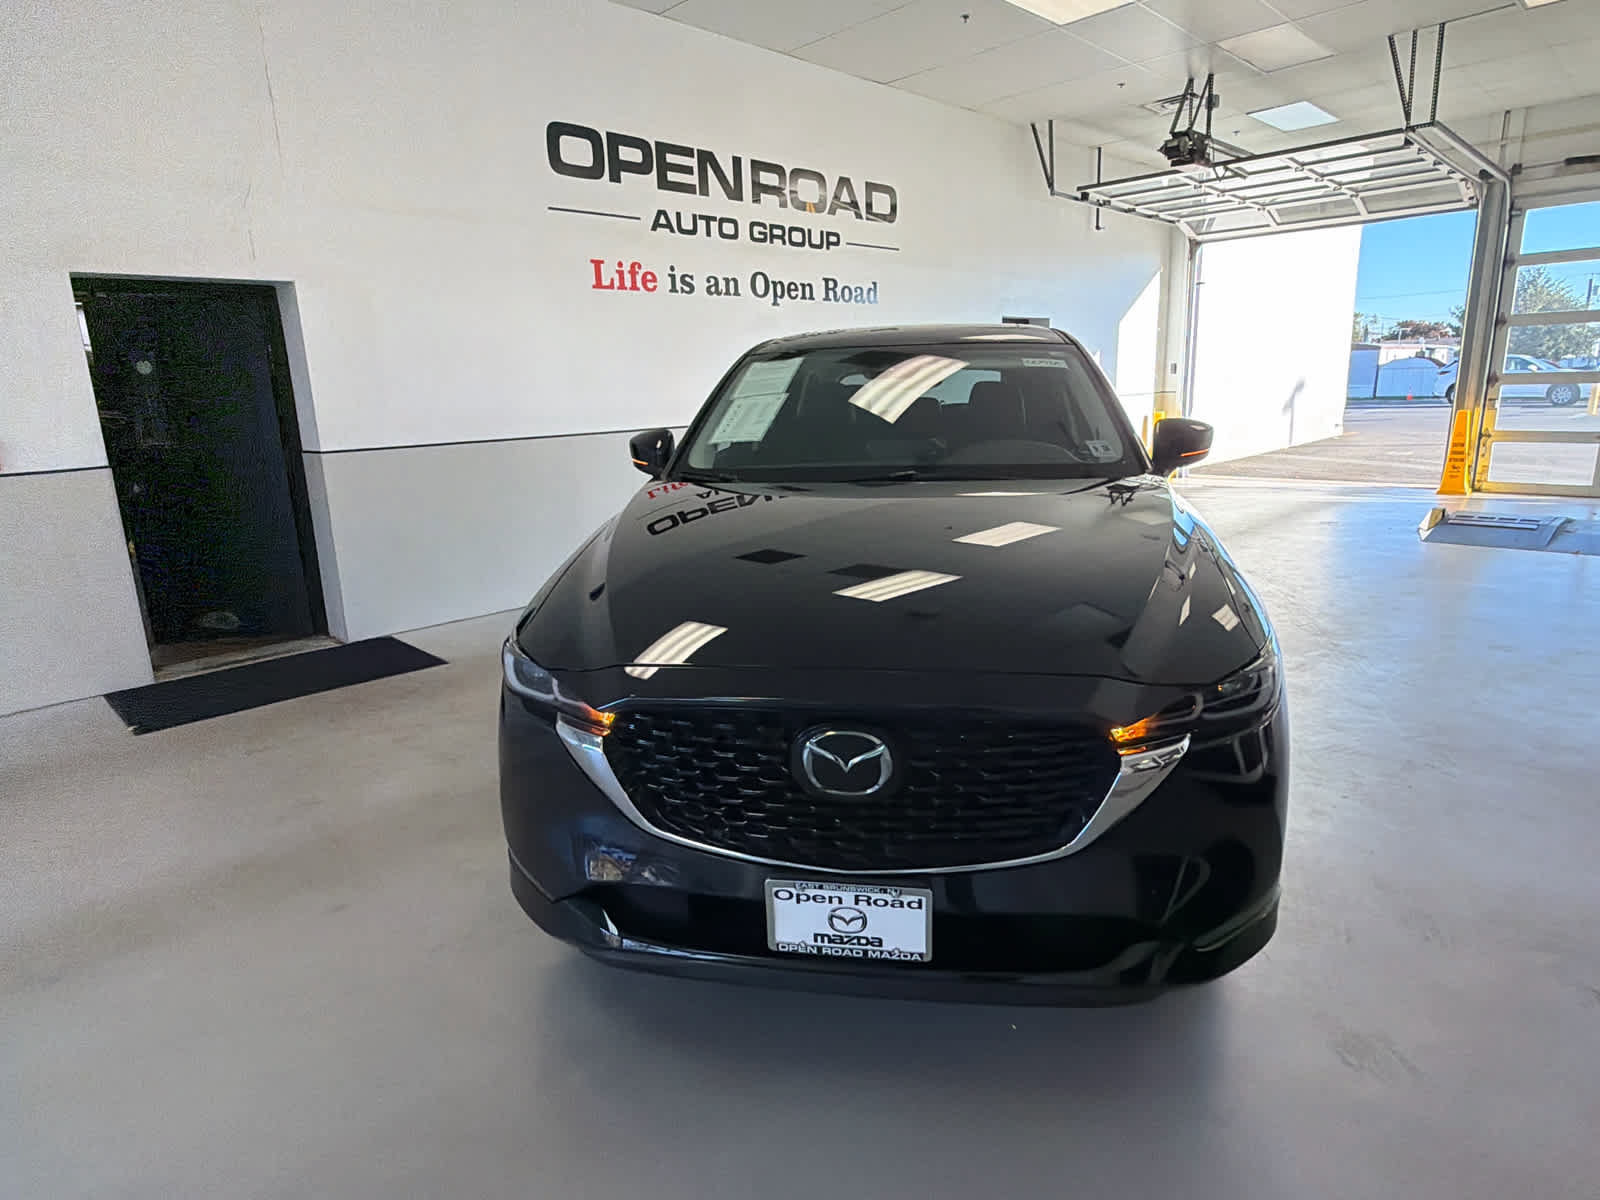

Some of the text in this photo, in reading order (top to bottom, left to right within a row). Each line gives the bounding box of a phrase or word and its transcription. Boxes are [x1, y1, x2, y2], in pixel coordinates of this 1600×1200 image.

[546, 121, 897, 224] OPEN ROAD
[650, 209, 841, 251] AUTO GROUP
[589, 259, 879, 306] Life is an Open Road
[795, 882, 819, 890] EAST
[774, 888, 923, 910] Open Road
[813, 932, 883, 948] mazda
[778, 943, 922, 961] OPEN ROAD MAZDA
